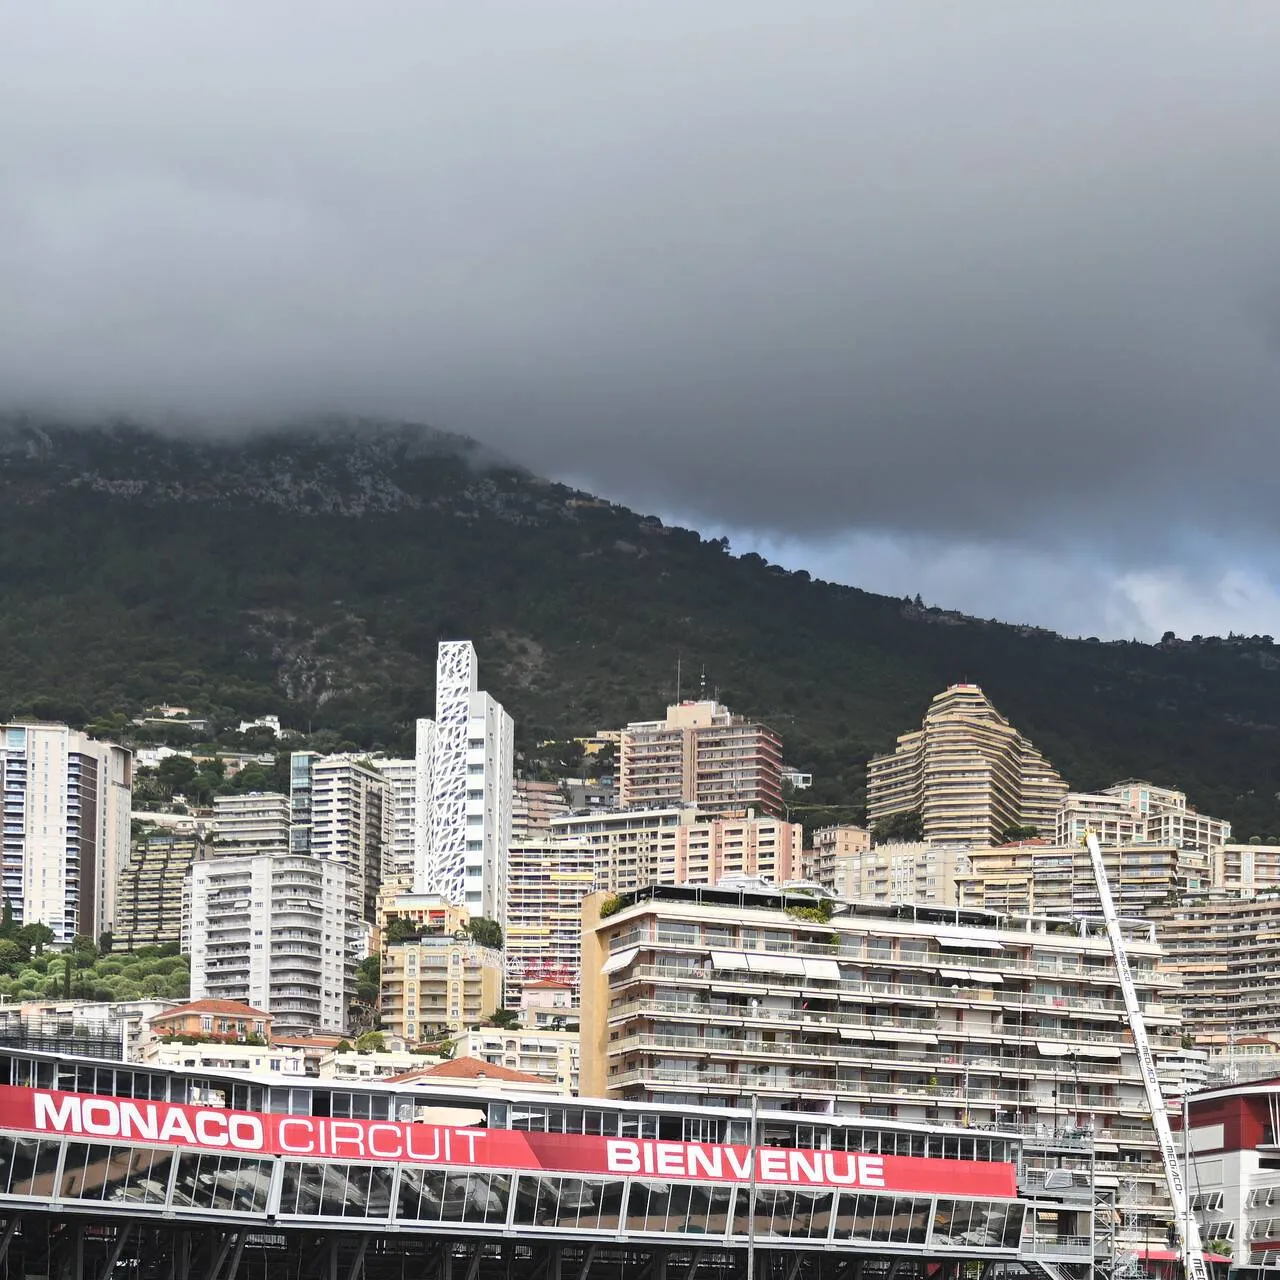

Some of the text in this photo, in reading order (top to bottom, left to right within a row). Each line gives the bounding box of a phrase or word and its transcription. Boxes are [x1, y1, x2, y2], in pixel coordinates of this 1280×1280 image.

[32, 1094, 487, 1163] MONACO CIRCUIT
[606, 1140, 886, 1187] BIENVENUE
